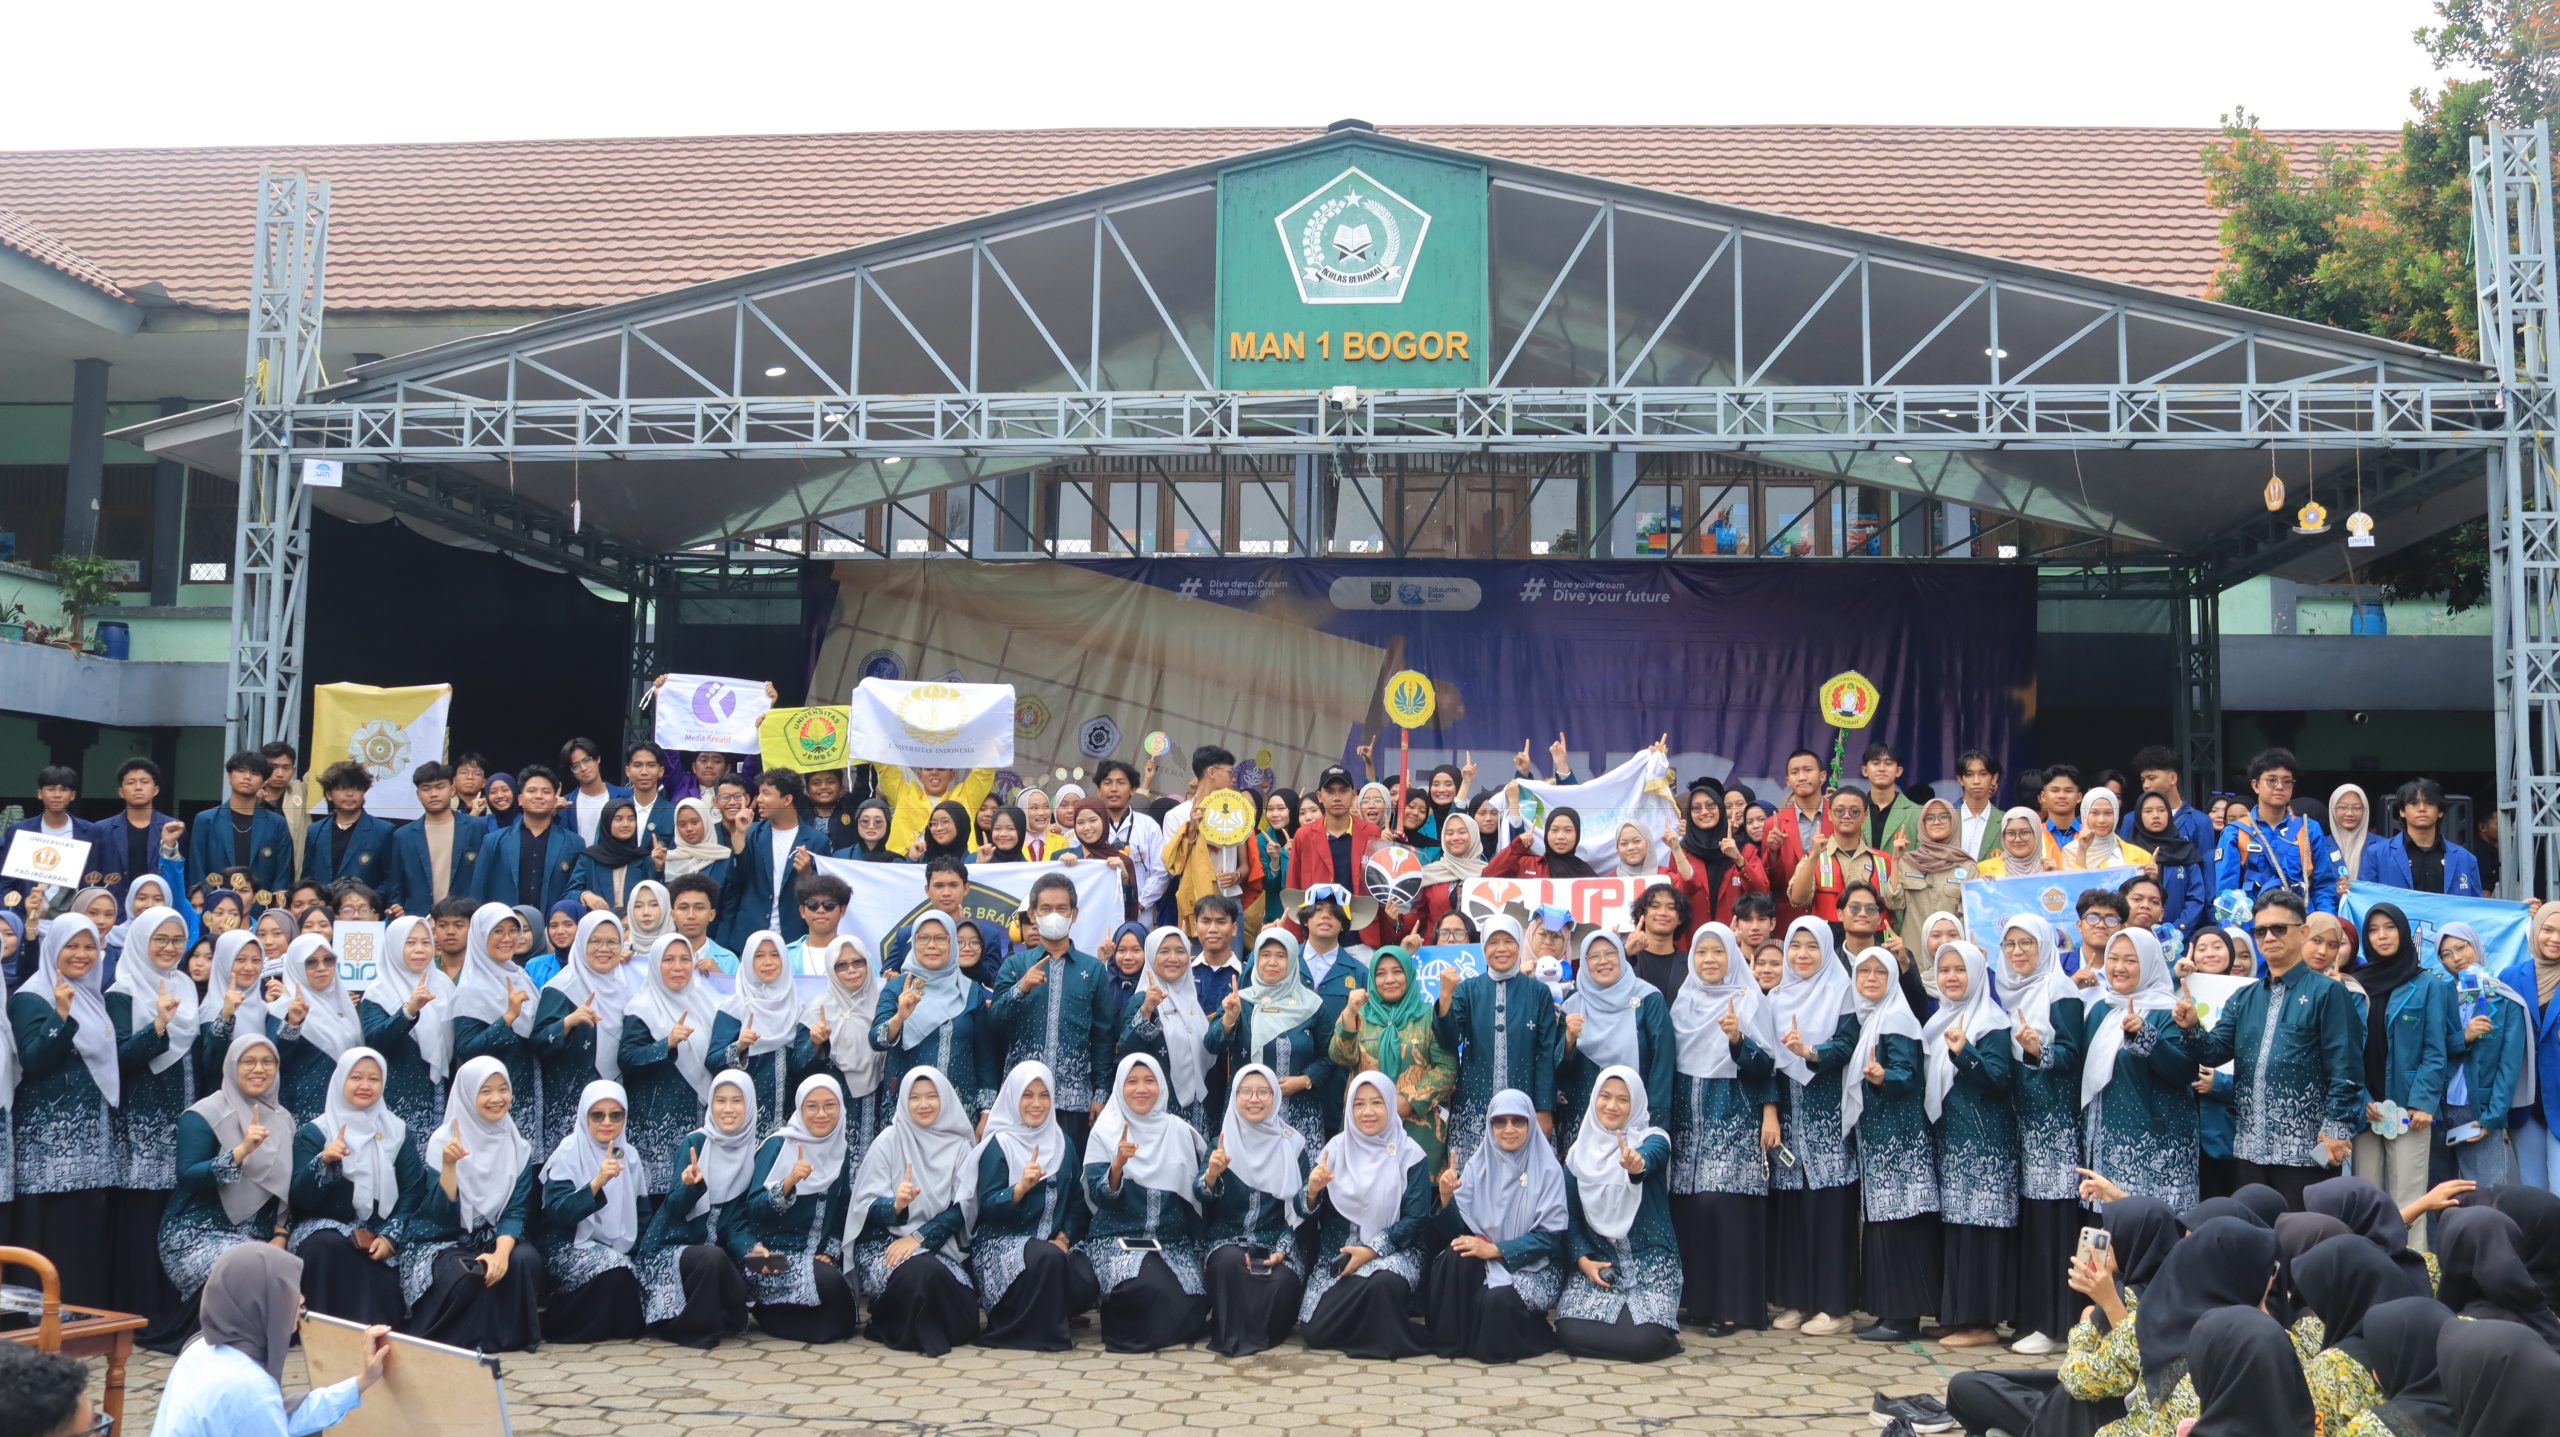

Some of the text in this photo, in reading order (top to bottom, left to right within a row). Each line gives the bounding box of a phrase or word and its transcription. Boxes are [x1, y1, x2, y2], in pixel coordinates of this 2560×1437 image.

[1321, 266, 1383, 283] IKHLAS BERAMAL
[1230, 331, 1469, 361] MAN 1 BOGOR
[1209, 580, 1230, 588] Dive
[1574, 582, 1595, 590] your
[1596, 581, 1625, 589] dream
[1248, 588, 1275, 598] bright
[1553, 589, 1670, 605] Dive your future
[794, 710, 840, 730] UNIVERSITAS
[684, 734, 732, 744] Media Kreatif
[802, 746, 837, 761] JEMBER
[889, 743, 933, 754] UNIVERSITAS
[30, 836, 75, 849] UNIVERSITAS
